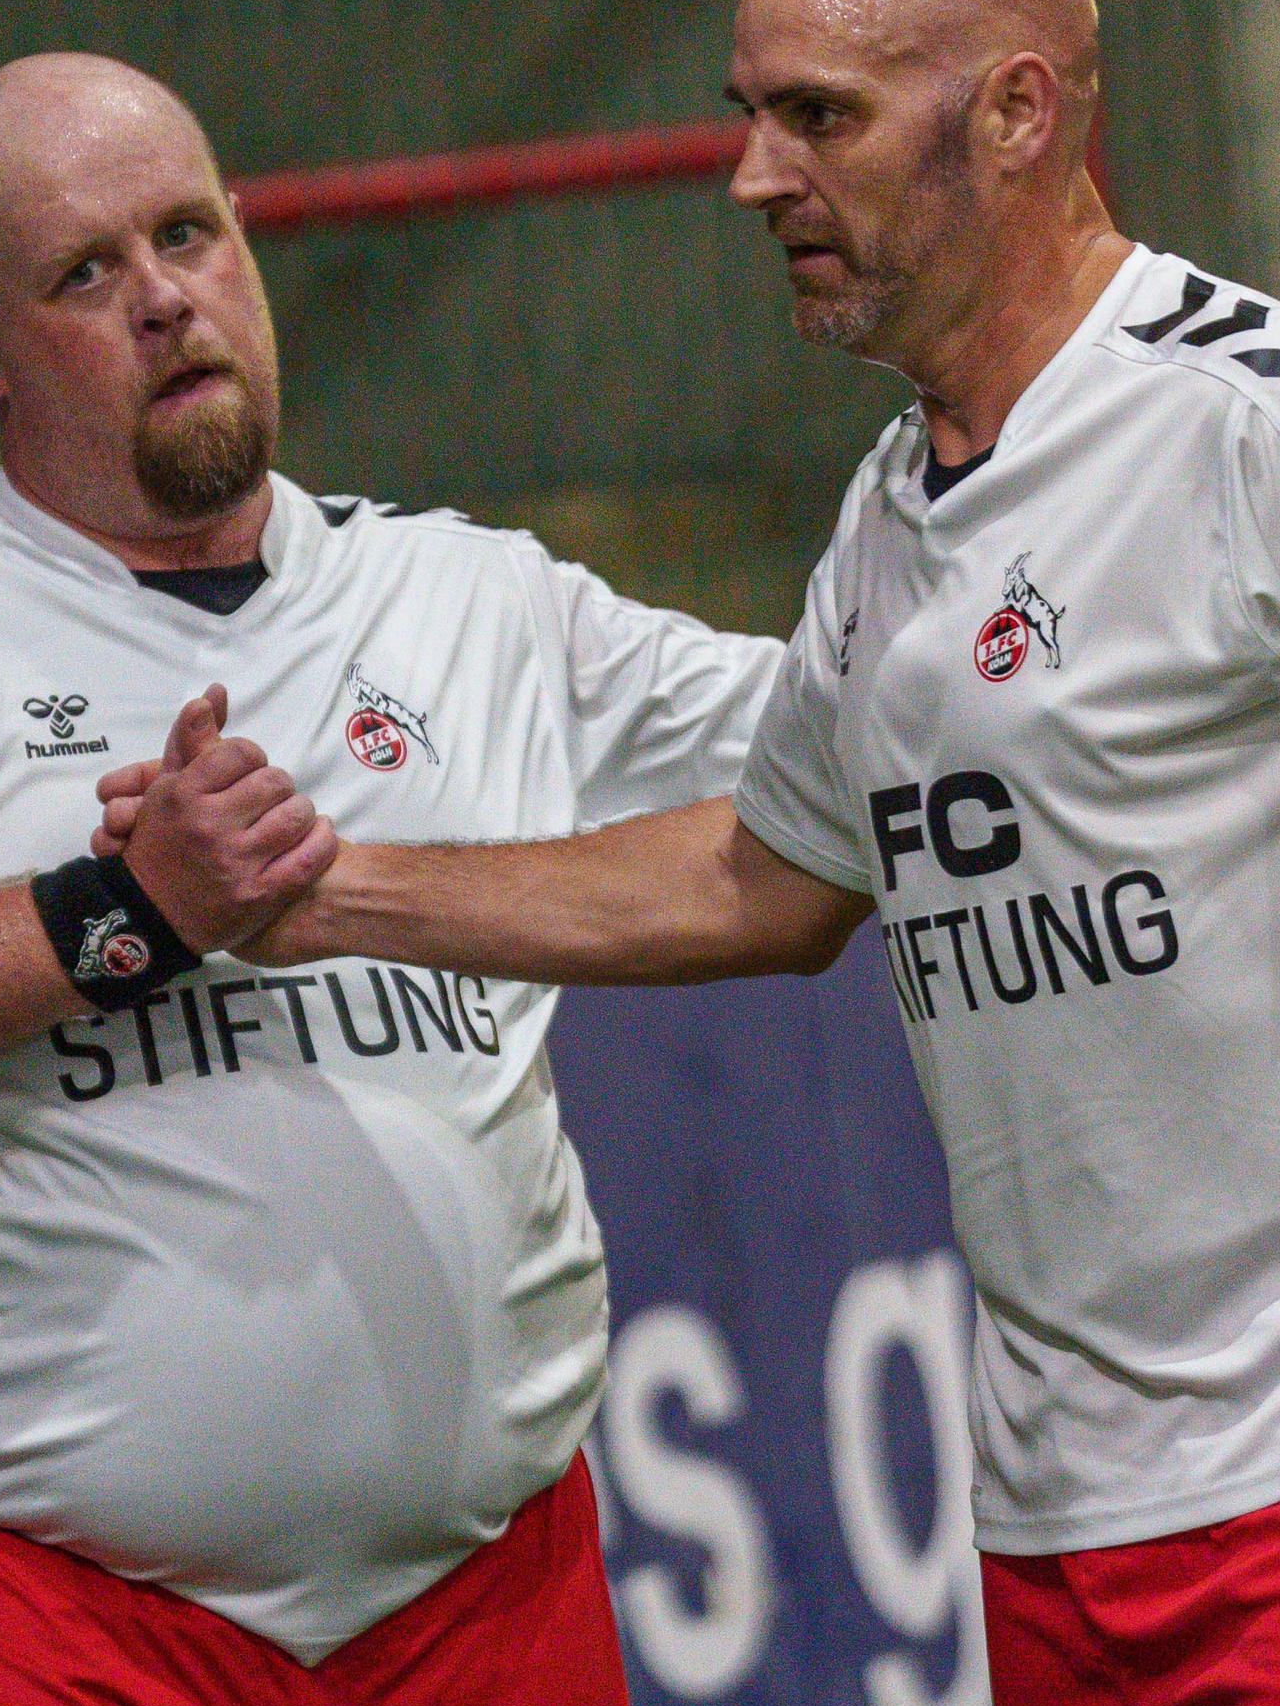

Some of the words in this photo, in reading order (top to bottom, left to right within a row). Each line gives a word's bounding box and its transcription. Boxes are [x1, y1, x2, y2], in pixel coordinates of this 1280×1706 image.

[25, 735, 109, 759] hummel
[869, 770, 1021, 892] FC
[50, 967, 500, 1103] STIFTUNG
